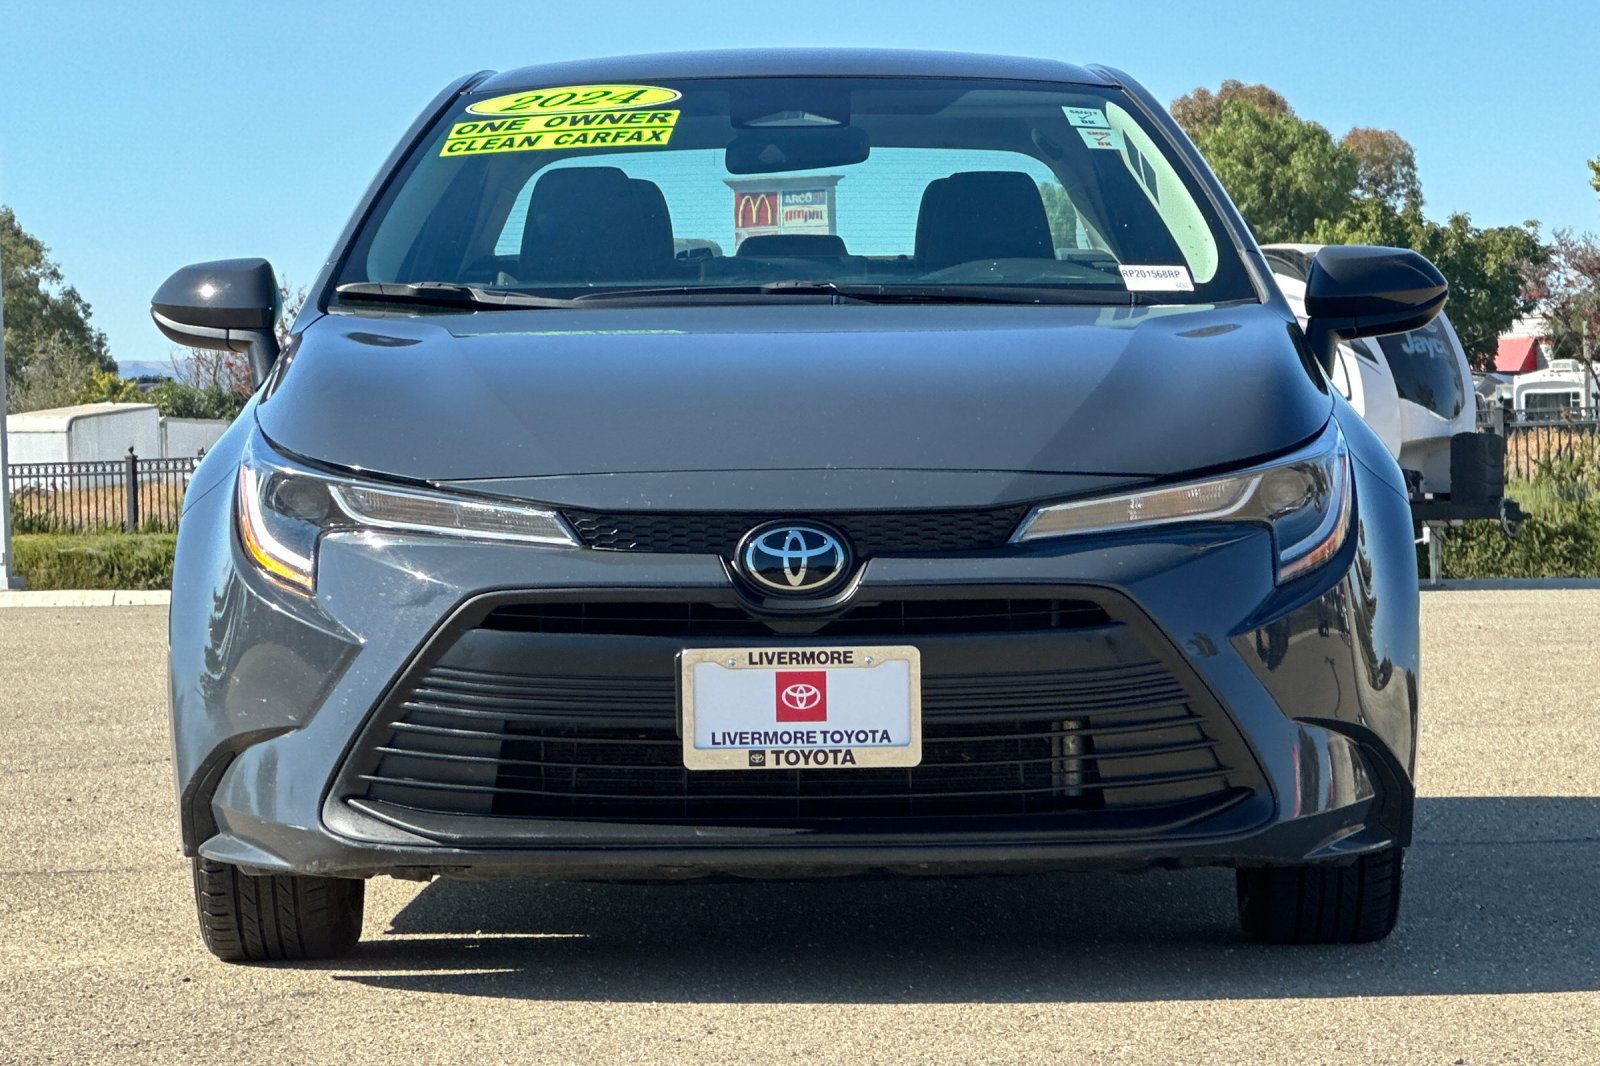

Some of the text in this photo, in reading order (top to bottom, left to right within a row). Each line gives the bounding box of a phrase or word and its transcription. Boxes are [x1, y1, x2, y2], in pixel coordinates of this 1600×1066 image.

[500, 89, 648, 112] 2024
[455, 112, 673, 136] ONE OWNER
[447, 129, 667, 153] CLEAN CARFAX
[784, 192, 813, 204] ARCO
[1121, 269, 1181, 279] RP201568RP
[748, 650, 854, 666] LIVERMORE
[711, 730, 892, 746] LIVERMORE TOYOTA
[770, 749, 857, 766] TOYOTA
